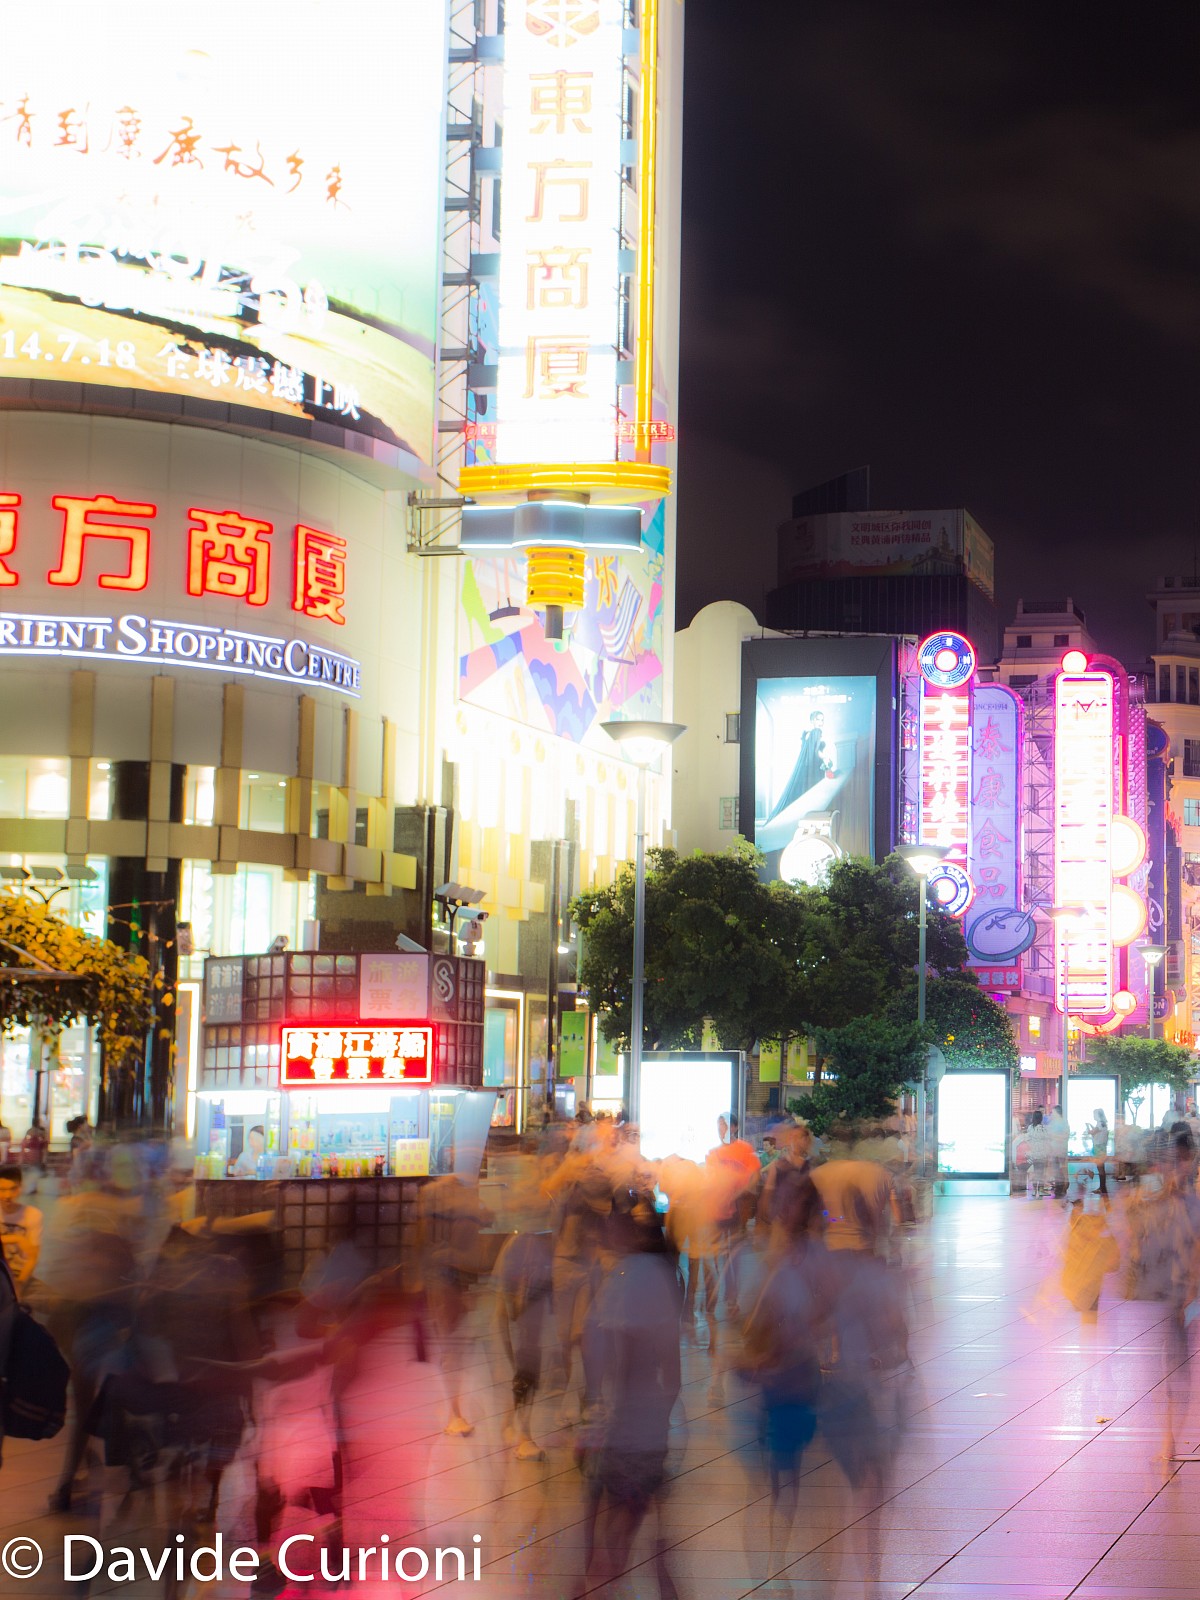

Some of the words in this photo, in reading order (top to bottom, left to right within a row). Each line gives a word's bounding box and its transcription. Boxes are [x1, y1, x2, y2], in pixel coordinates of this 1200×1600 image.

[0, 494, 346, 625] 方商厦
[117, 615, 283, 670] SHOPPING
[284, 639, 361, 690] CENTRE
